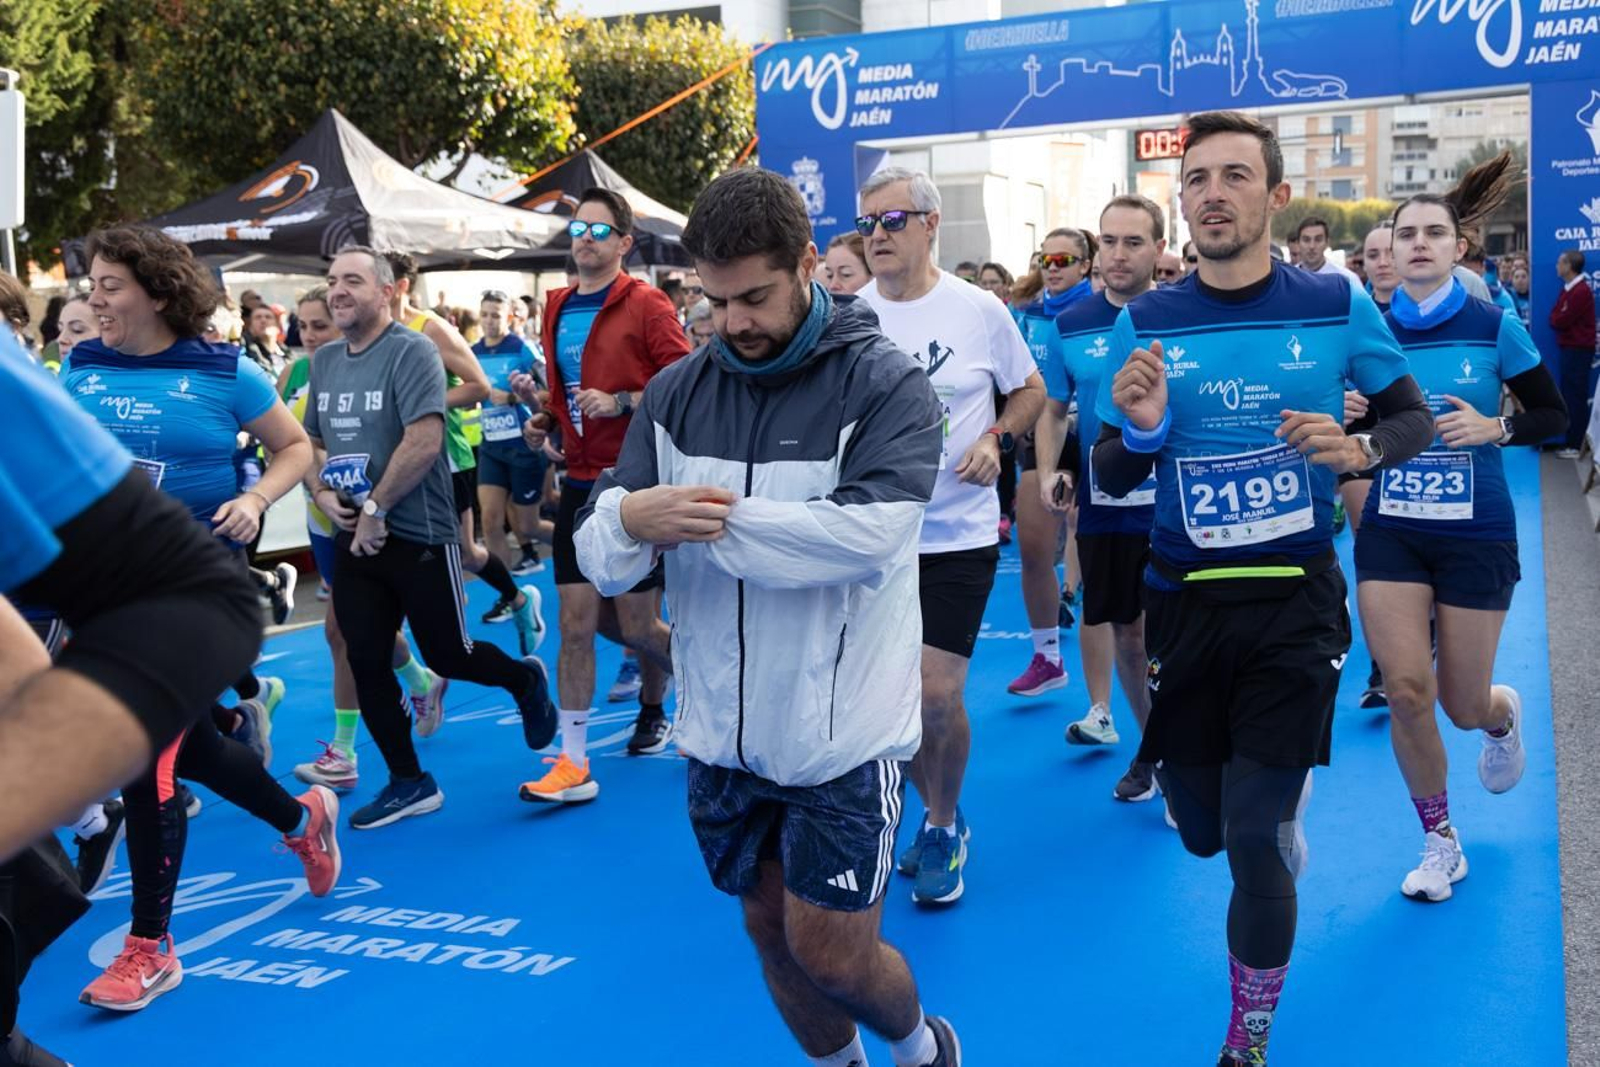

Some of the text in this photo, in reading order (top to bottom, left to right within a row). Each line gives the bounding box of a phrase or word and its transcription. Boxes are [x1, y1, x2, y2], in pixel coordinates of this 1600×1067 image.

[1533, 16, 1600, 39] MARA
[1524, 42, 1582, 65] JAÉN
[857, 63, 913, 84] MEDIA
[854, 81, 939, 105] MARATÓN
[849, 107, 892, 127] JAÉN
[1555, 227, 1588, 240] CAJA
[1242, 392, 1281, 402] MARATÓN
[1244, 384, 1269, 392] MEDIA
[337, 392, 354, 413] 57
[364, 390, 383, 411] 19
[1241, 402, 1260, 410] JAÉN
[1190, 470, 1299, 515] 2199
[1387, 467, 1465, 495] 2523
[1242, 507, 1277, 518] MANUEL
[321, 905, 521, 937] MEDIA
[251, 928, 575, 977] MARATÓN
[184, 957, 350, 989] JAÉN
